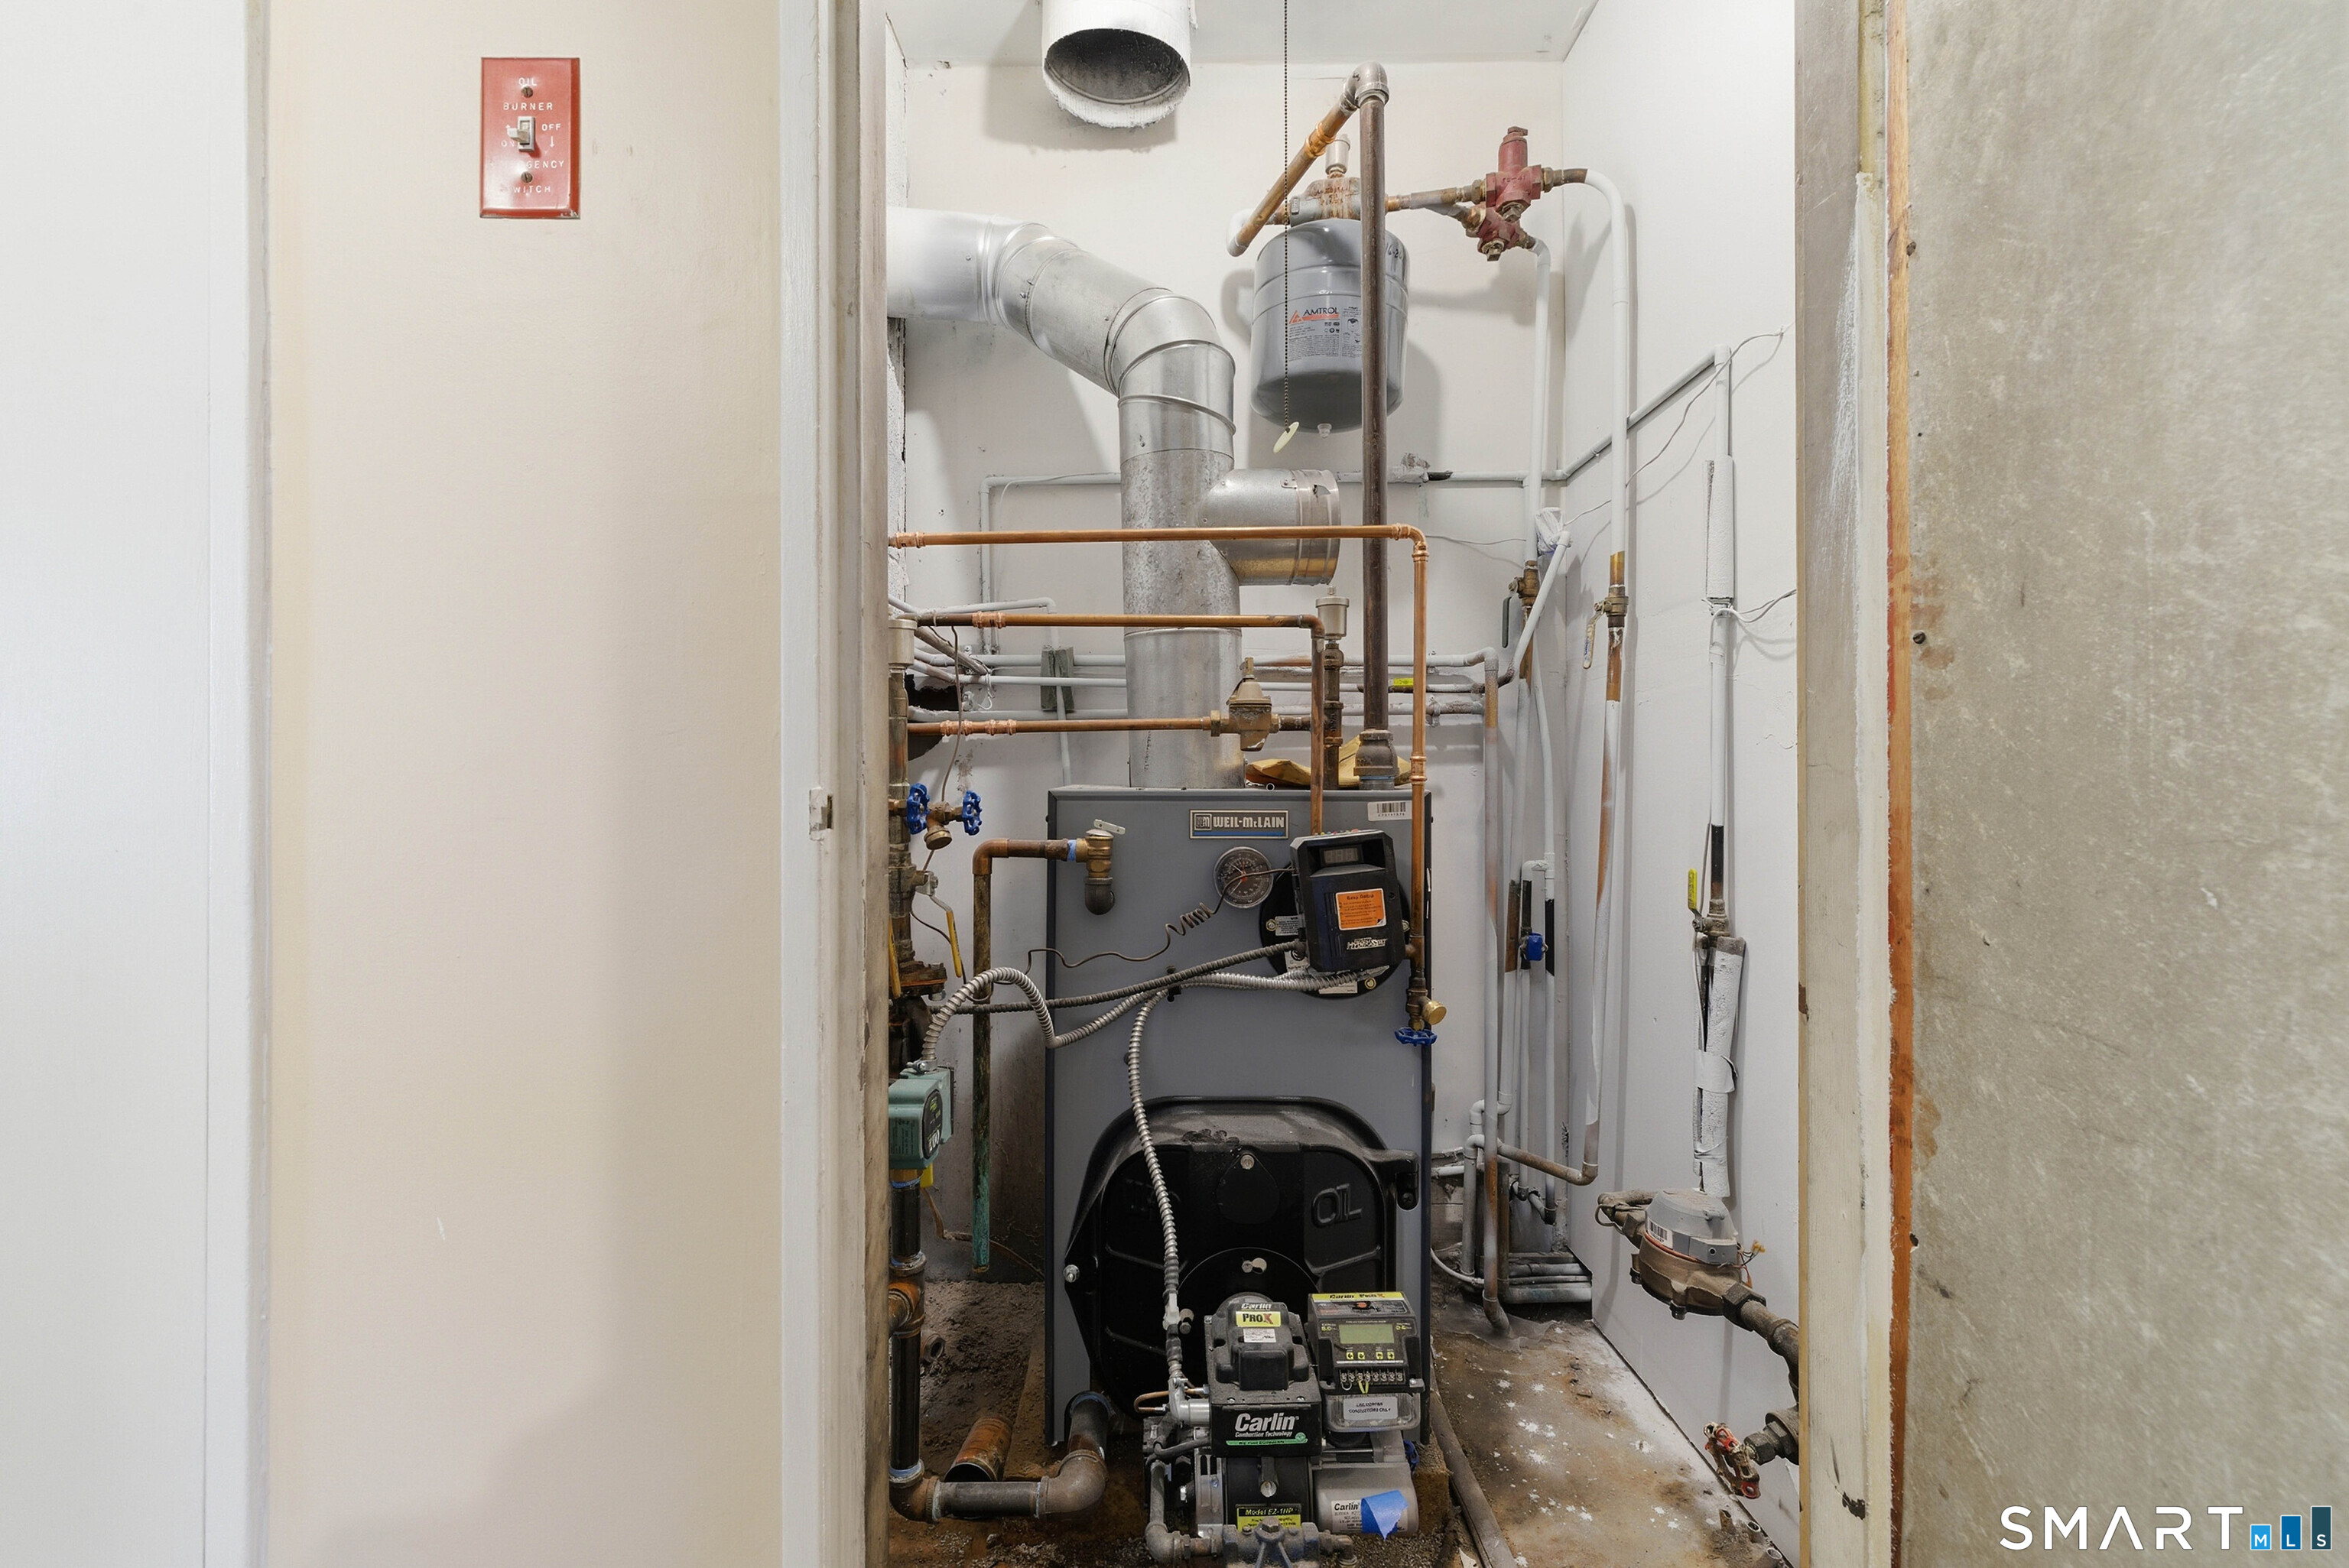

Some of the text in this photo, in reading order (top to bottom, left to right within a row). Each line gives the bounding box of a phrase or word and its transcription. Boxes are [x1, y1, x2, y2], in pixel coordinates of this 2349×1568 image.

[518, 77, 538, 86] OIL
[503, 102, 553, 111] BURNER
[541, 123, 560, 131] OFF
[514, 185, 551, 193] WITCH
[1303, 307, 1339, 316] AMTROL
[1213, 816, 1285, 828] WEIL-McLAIN
[1235, 1412, 1298, 1432] Carlin
[1334, 1501, 1359, 1511] Carlin
